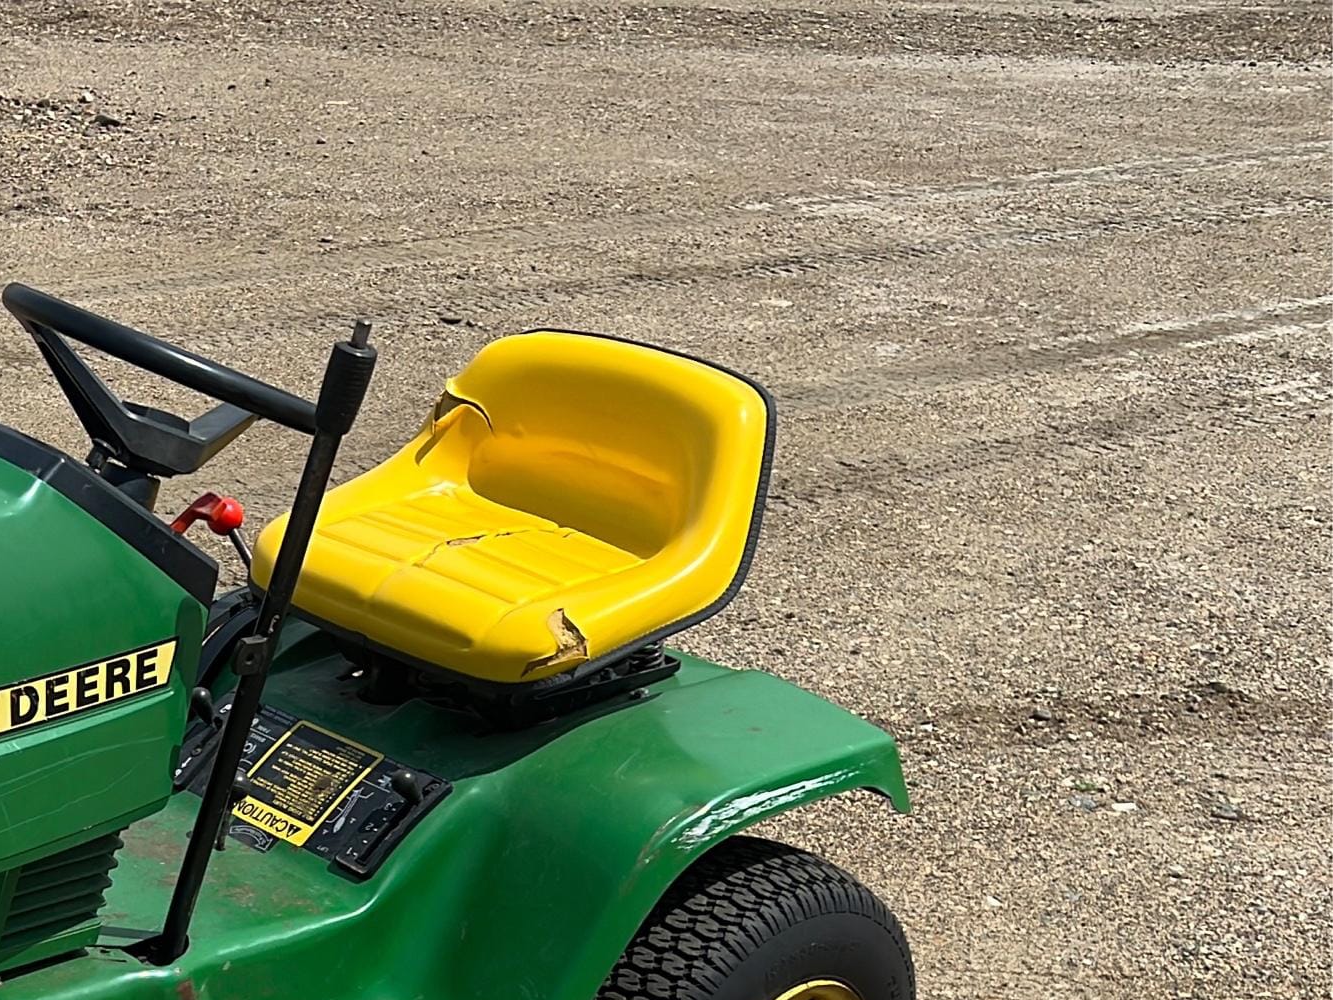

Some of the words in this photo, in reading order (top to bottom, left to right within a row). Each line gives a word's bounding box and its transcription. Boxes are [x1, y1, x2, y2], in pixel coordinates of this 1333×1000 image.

[10, 648, 158, 727] DEERE
[236, 801, 289, 833] CAUTION
[365, 822, 375, 831] 2
